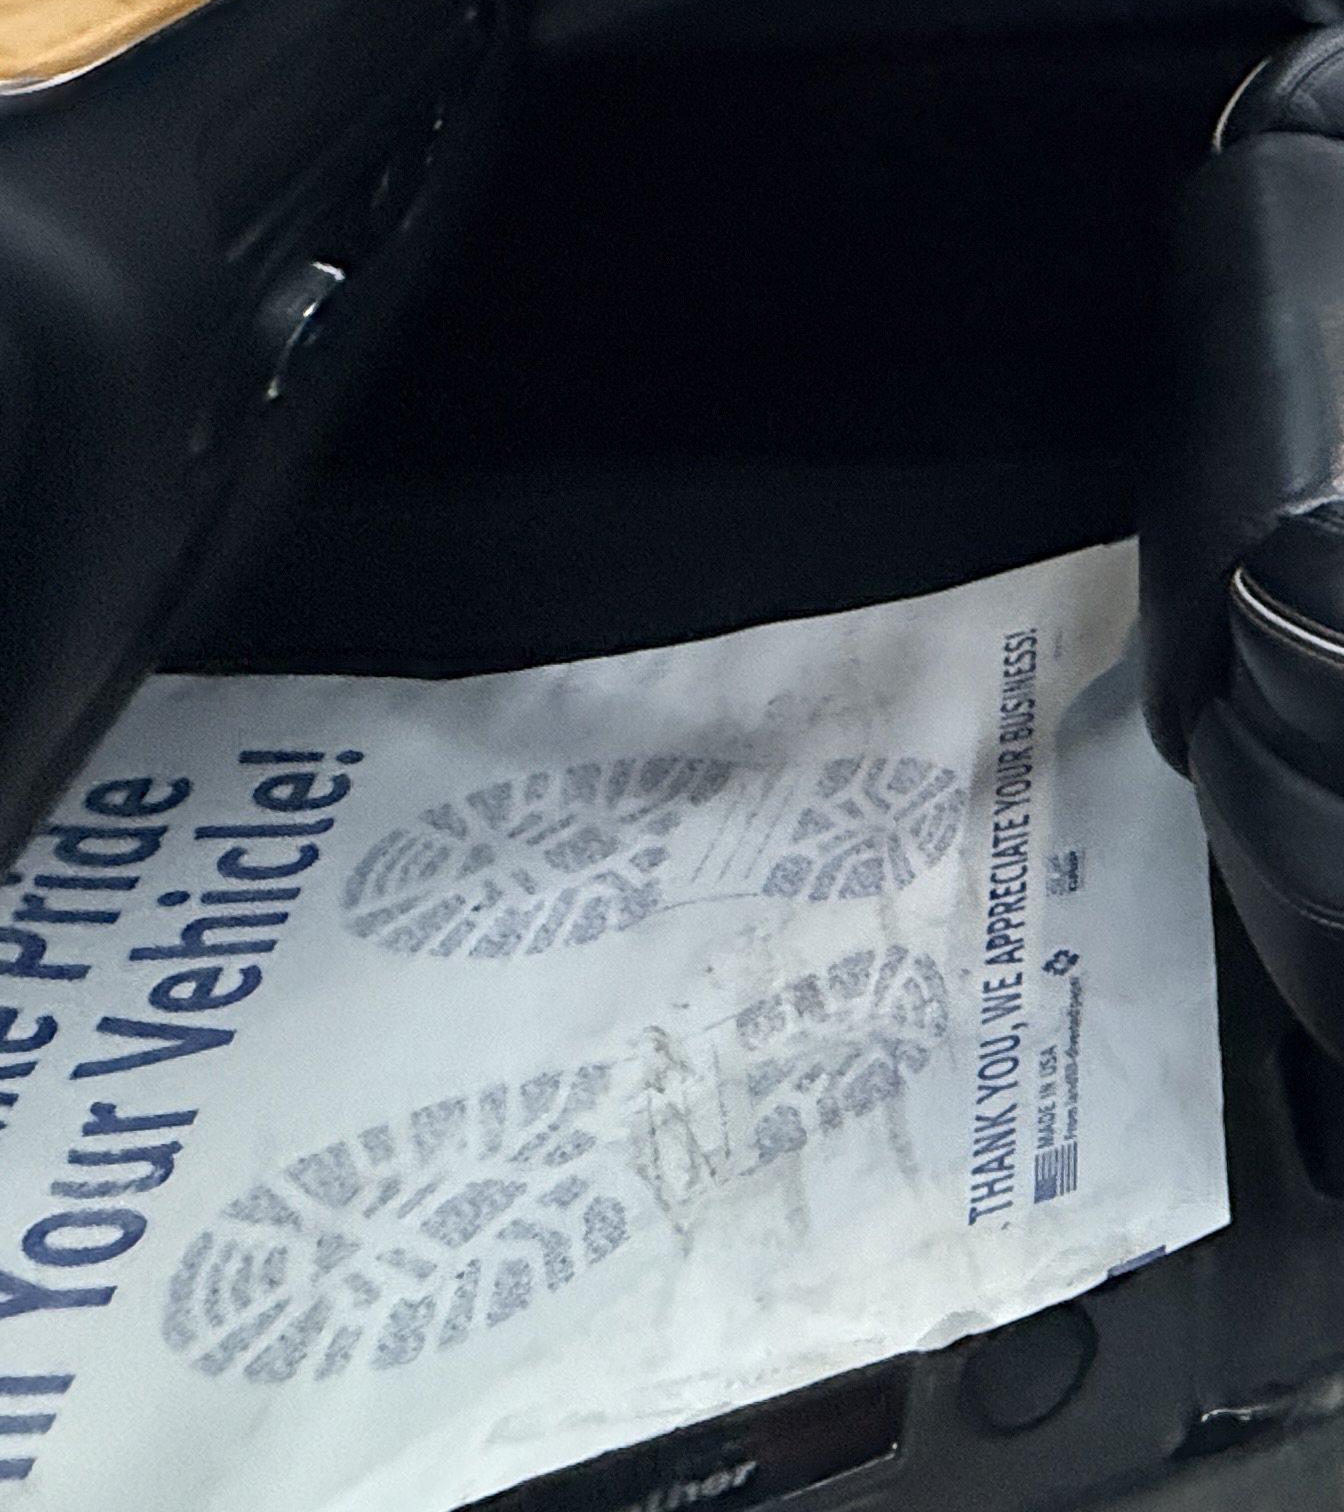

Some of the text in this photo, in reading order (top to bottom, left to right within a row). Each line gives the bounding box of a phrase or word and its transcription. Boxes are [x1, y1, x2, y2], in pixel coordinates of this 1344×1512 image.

[0, 777, 194, 982] Pride
[967, 627, 1038, 1226] THANK YOU, WE APPRECIATE YOUR BUSINESS!
[0, 749, 365, 1320] Your Vehicle!
[1037, 1101, 1056, 1150] MADE
[1039, 1044, 1058, 1078] USA
